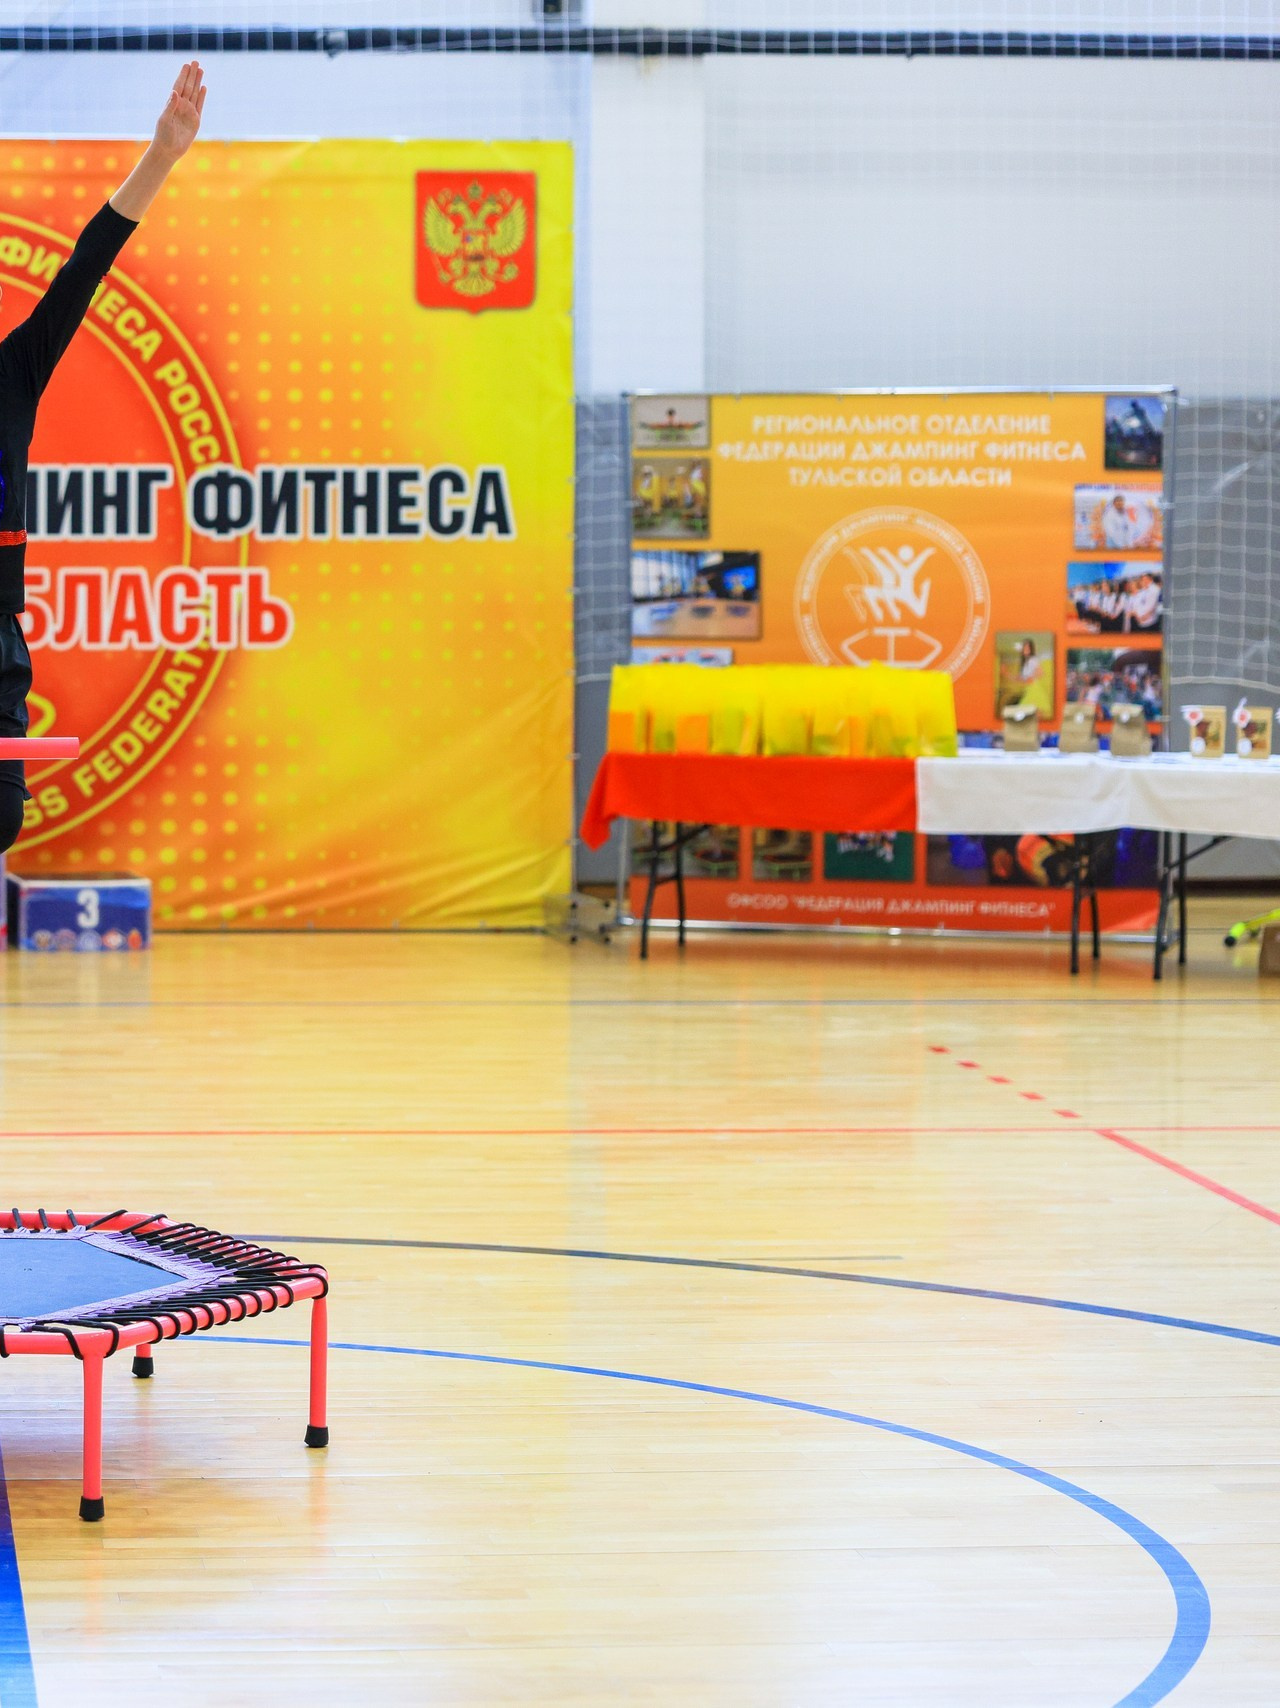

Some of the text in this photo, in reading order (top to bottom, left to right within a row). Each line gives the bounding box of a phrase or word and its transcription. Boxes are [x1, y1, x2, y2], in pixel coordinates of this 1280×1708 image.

[154, 359, 221, 470] РОСС
[752, 414, 1051, 436] РЕГИОНАЛЬНОЕ ОТДЕЛЕНИЕ
[719, 440, 1087, 463] ФЕДЕРАЦИИ ДЖАМПИНГ ФИТНЕСА
[789, 464, 1012, 487] ТУЛЬСКОЙ ОБЛАСТИ
[191, 466, 513, 538] ФИТНЕСА
[23, 568, 293, 649] БЛАСТЬ
[72, 648, 205, 798] FEDERAT
[76, 889, 101, 929] 3
